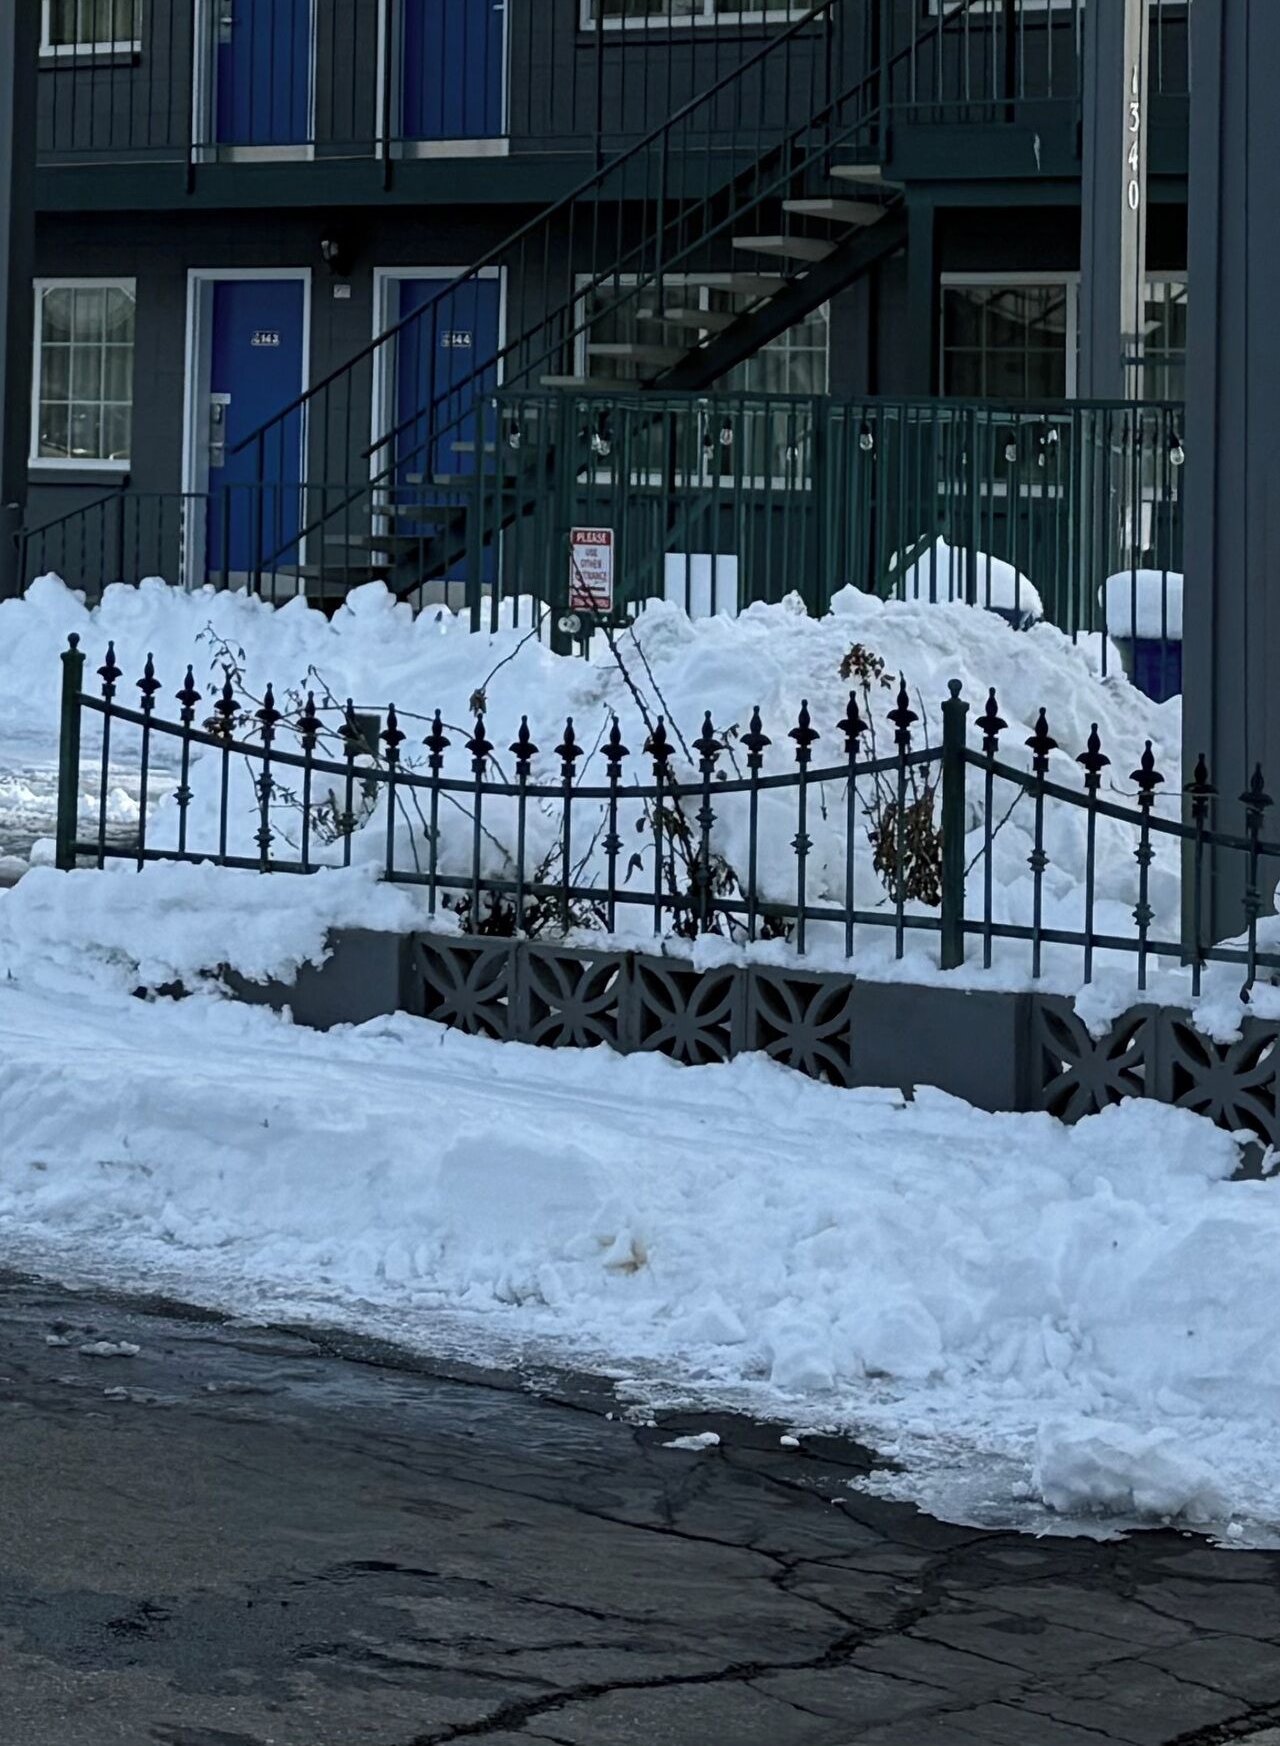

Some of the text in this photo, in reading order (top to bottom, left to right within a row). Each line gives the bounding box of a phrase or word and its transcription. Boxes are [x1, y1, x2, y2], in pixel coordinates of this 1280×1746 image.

[1128, 64, 1140, 210] 1340
[576, 532, 606, 544] PLEASE
[575, 571, 607, 582] TRANCE
